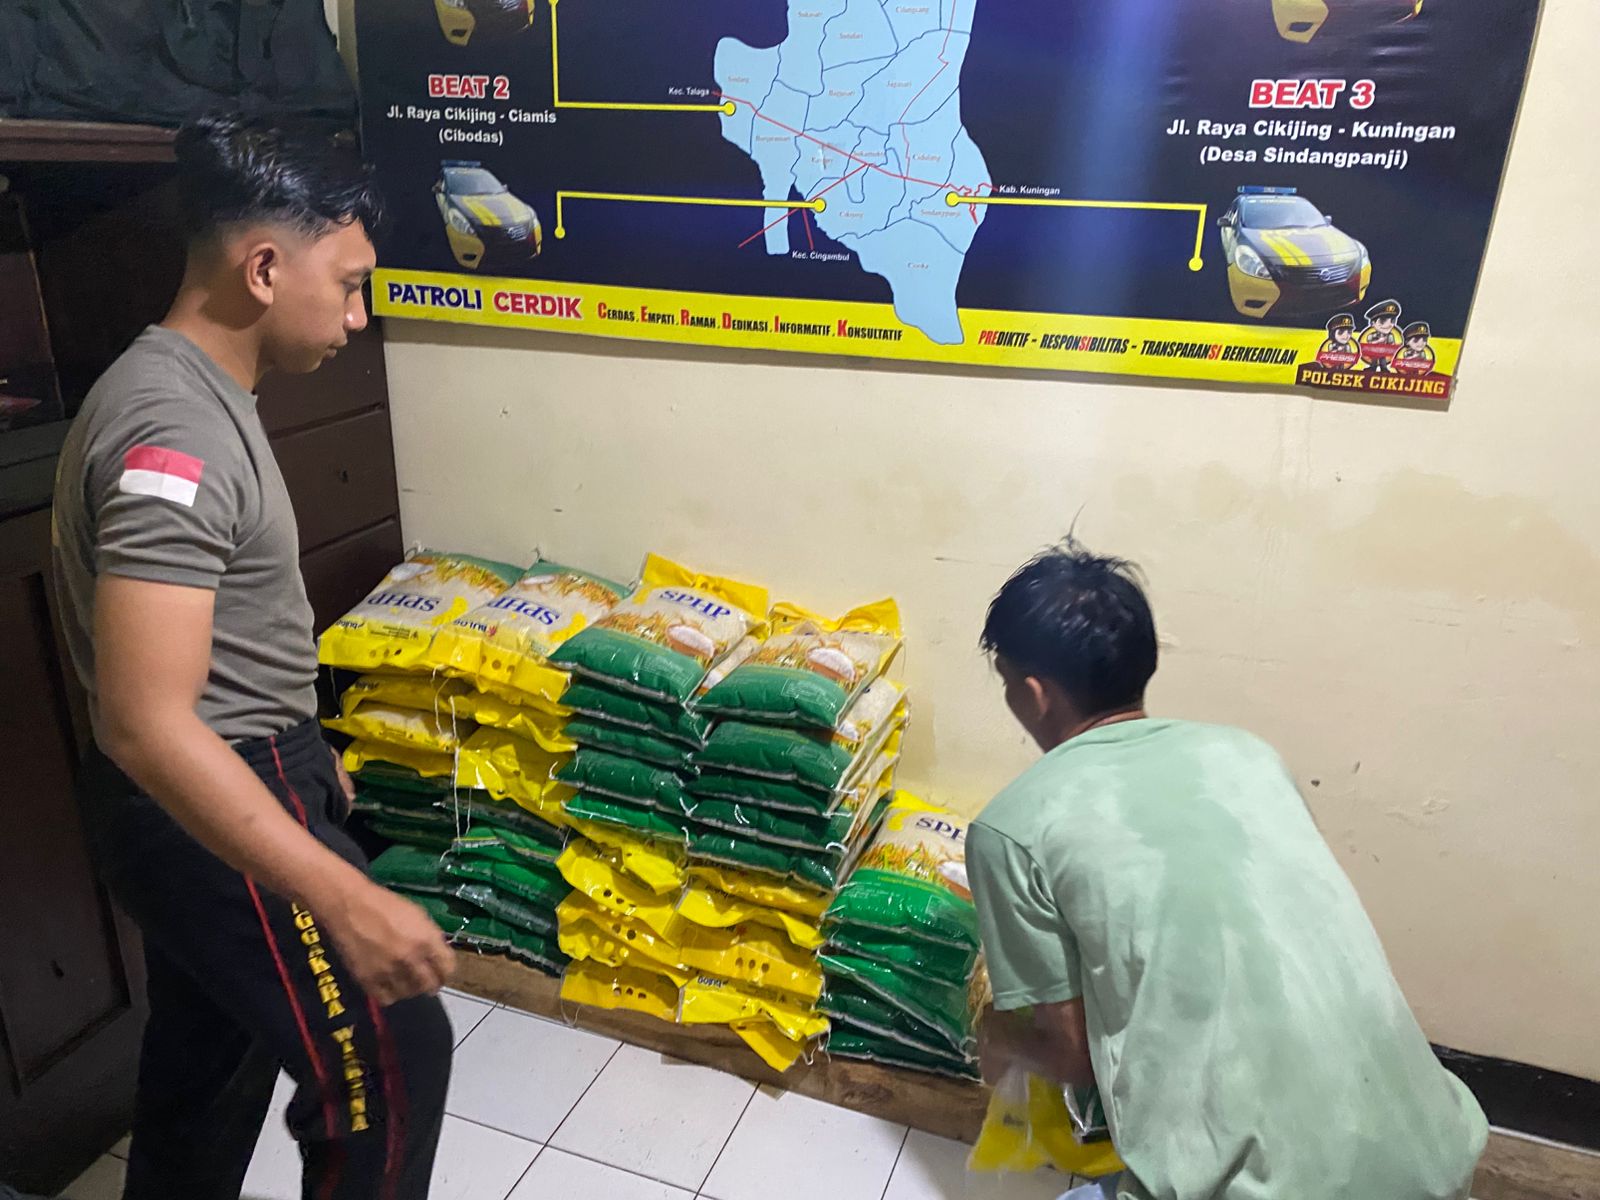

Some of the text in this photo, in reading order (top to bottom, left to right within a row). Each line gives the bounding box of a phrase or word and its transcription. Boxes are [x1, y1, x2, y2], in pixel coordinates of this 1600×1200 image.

[428, 74, 510, 99] BEAT 2
[668, 87, 710, 96] Kec. Talaga
[1249, 79, 1375, 110] BEAT 3
[386, 105, 403, 119] Jl.
[407, 106, 441, 122] Raya
[444, 108, 496, 124] Cikijing
[508, 109, 557, 123] Ciamis
[439, 128, 504, 146] (Cibodas)
[1166, 119, 1190, 136] Jl.
[1197, 120, 1247, 139] Raya
[1253, 120, 1332, 141] Cikijing
[1351, 121, 1456, 143] Kuningan
[1200, 146, 1409, 169] (Desa Sindangpanji)
[999, 185, 1061, 196] Kab. Kuningan
[792, 251, 850, 261] Kec. Cingambul
[388, 282, 583, 320] PATROLI CERDIK
[597, 302, 635, 322] CERDAS
[640, 306, 674, 325] EMPATI
[680, 309, 716, 329] RAMAH
[722, 312, 768, 332] DEDIKASI
[774, 316, 831, 336] INFORMATIF
[836, 319, 903, 341] KONSULTATIF
[978, 330, 1029, 348] PREDIKTIF
[1039, 333, 1129, 354] RESPONSIBILITAS
[1140, 340, 1222, 361] TRANSPARANSI
[1221, 346, 1298, 366] BERKEADILAN
[1301, 369, 1446, 395] POLSEK CIKIJING
[367, 593, 441, 612] SPHP
[487, 596, 560, 625] SPHP
[660, 590, 731, 618] SPHP
